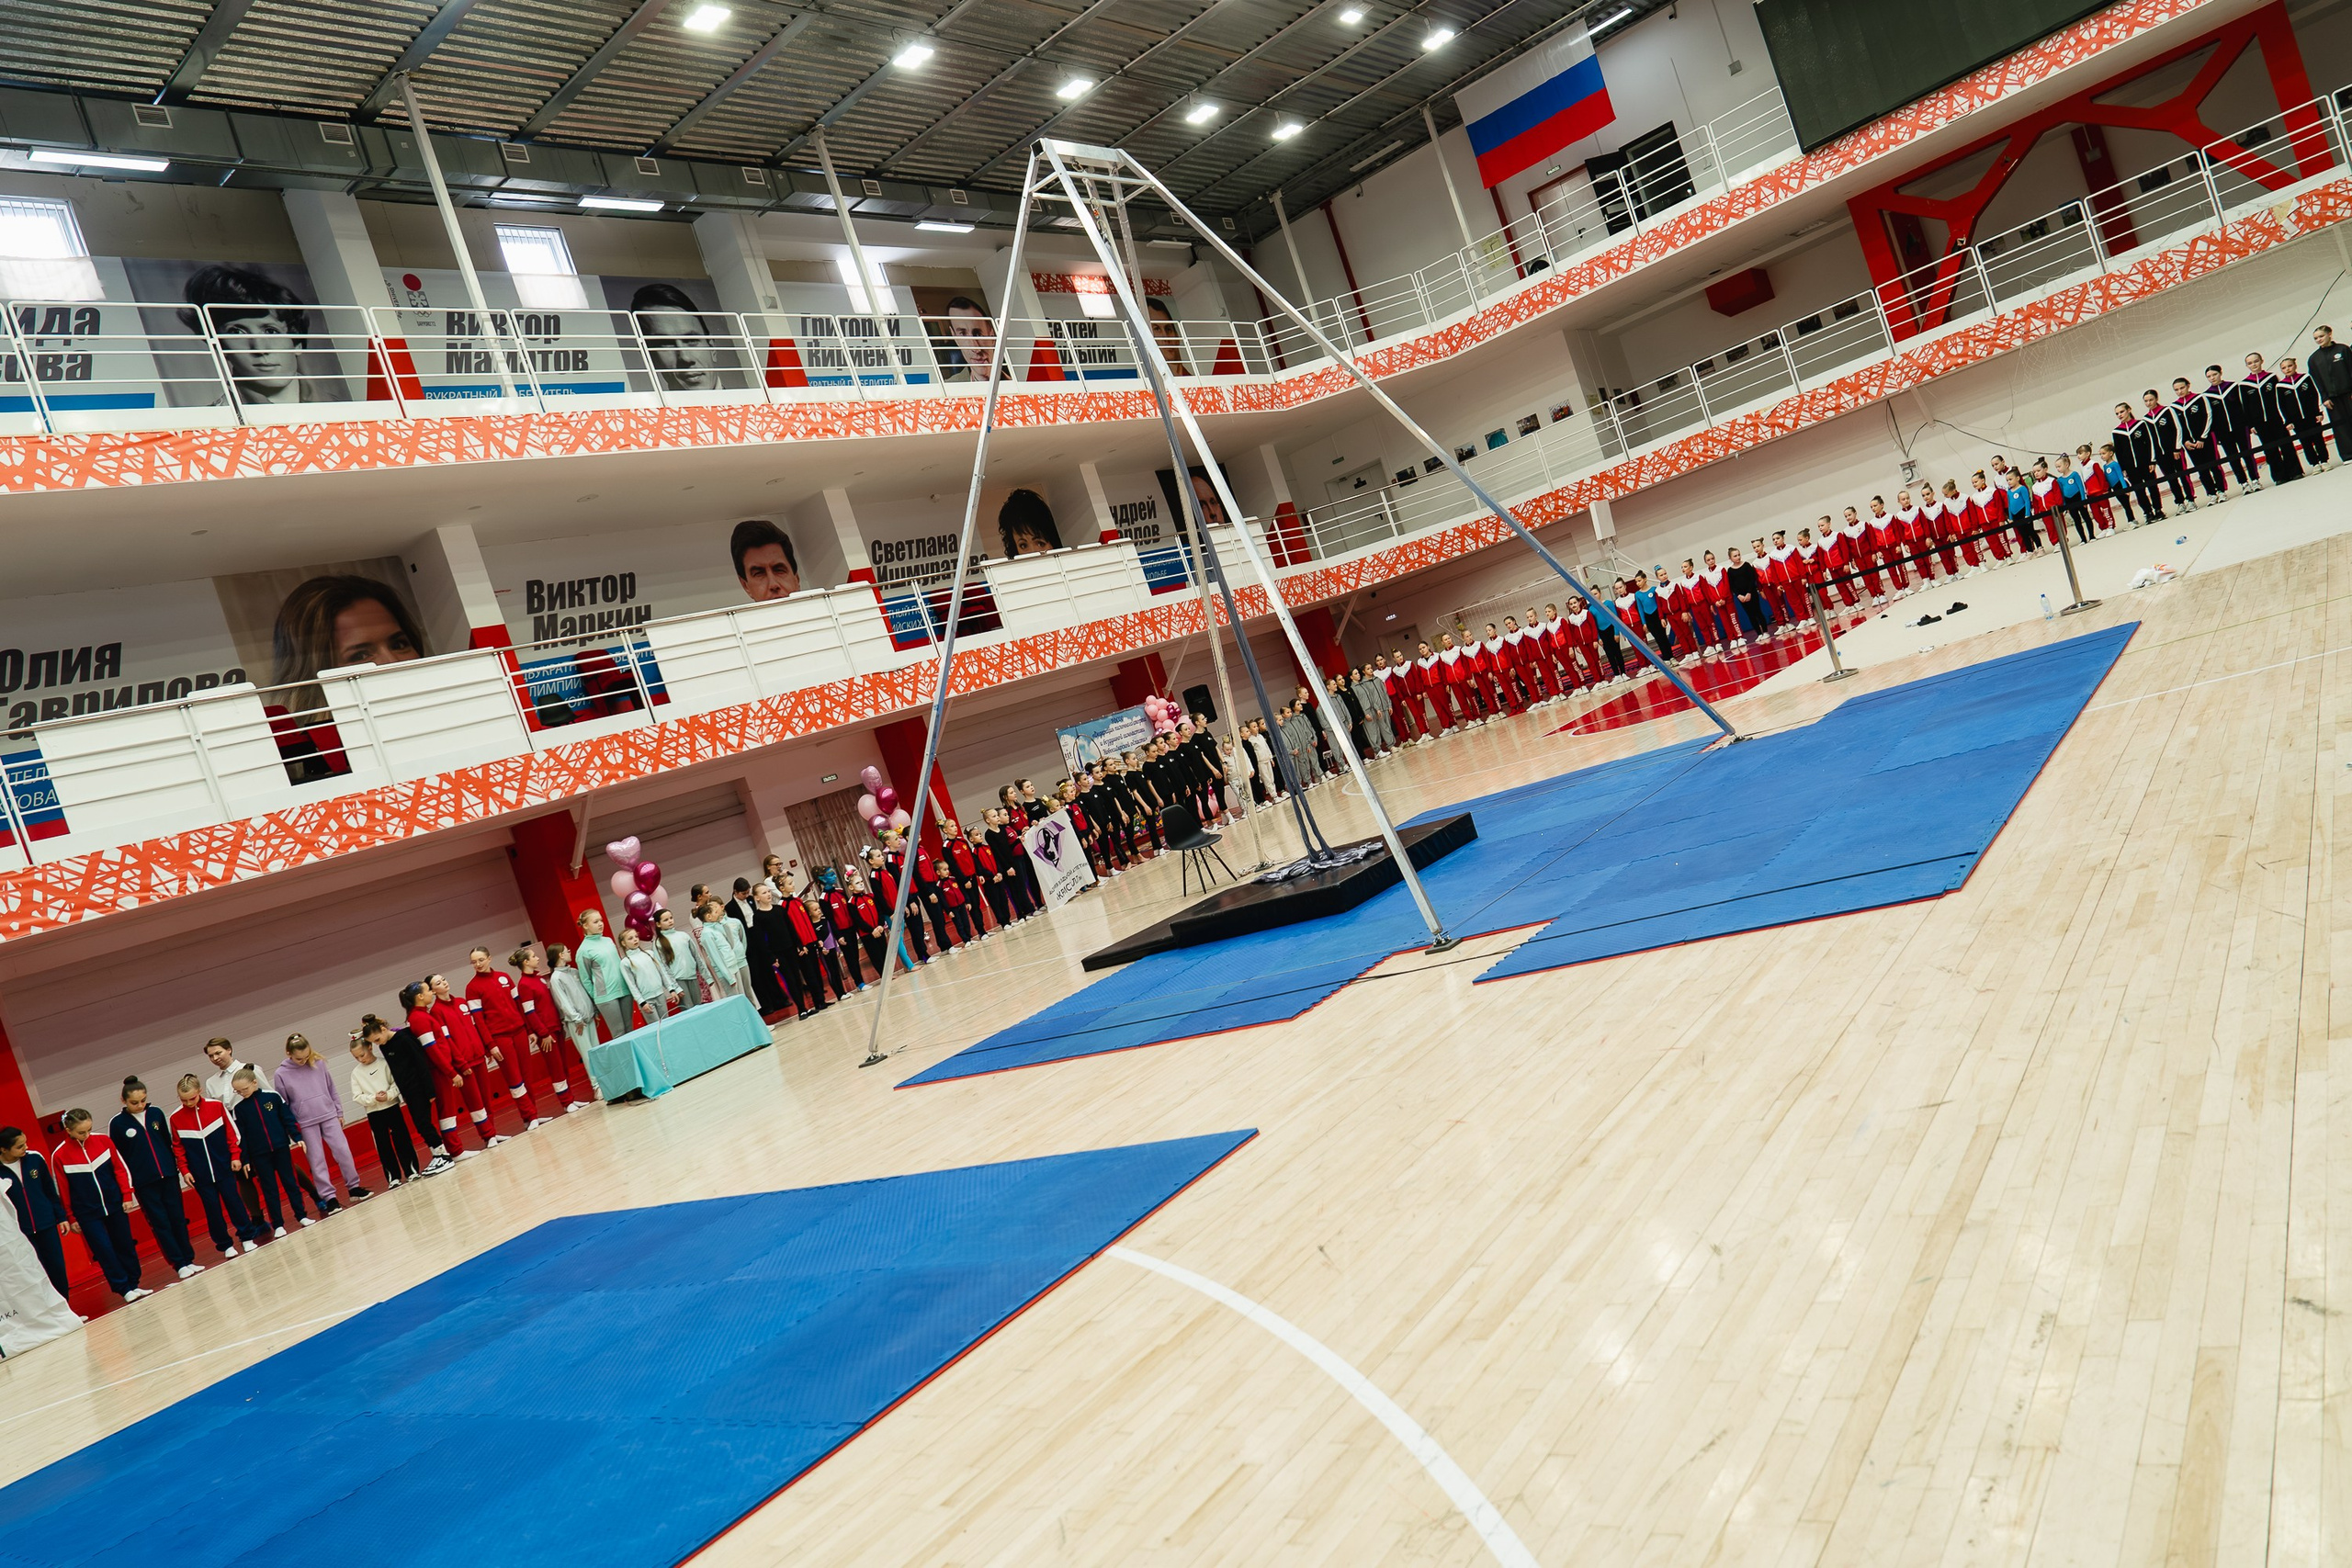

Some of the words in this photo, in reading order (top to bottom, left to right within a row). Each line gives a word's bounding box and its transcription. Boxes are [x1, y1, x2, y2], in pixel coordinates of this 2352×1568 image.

[0, 306, 100, 346] ида
[0, 350, 93, 381] ова
[807, 340, 912, 370] Кириено
[1054, 341, 1117, 365] улыгин
[425, 389, 498, 400] ВУКРАТНЫЙ
[1109, 495, 1158, 527] ндрей
[871, 533, 958, 565] Светлана
[876, 553, 989, 591] Ишмуратва
[526, 571, 637, 615] Виктор
[533, 604, 651, 651] Маркин
[0, 668, 246, 741] аврило
